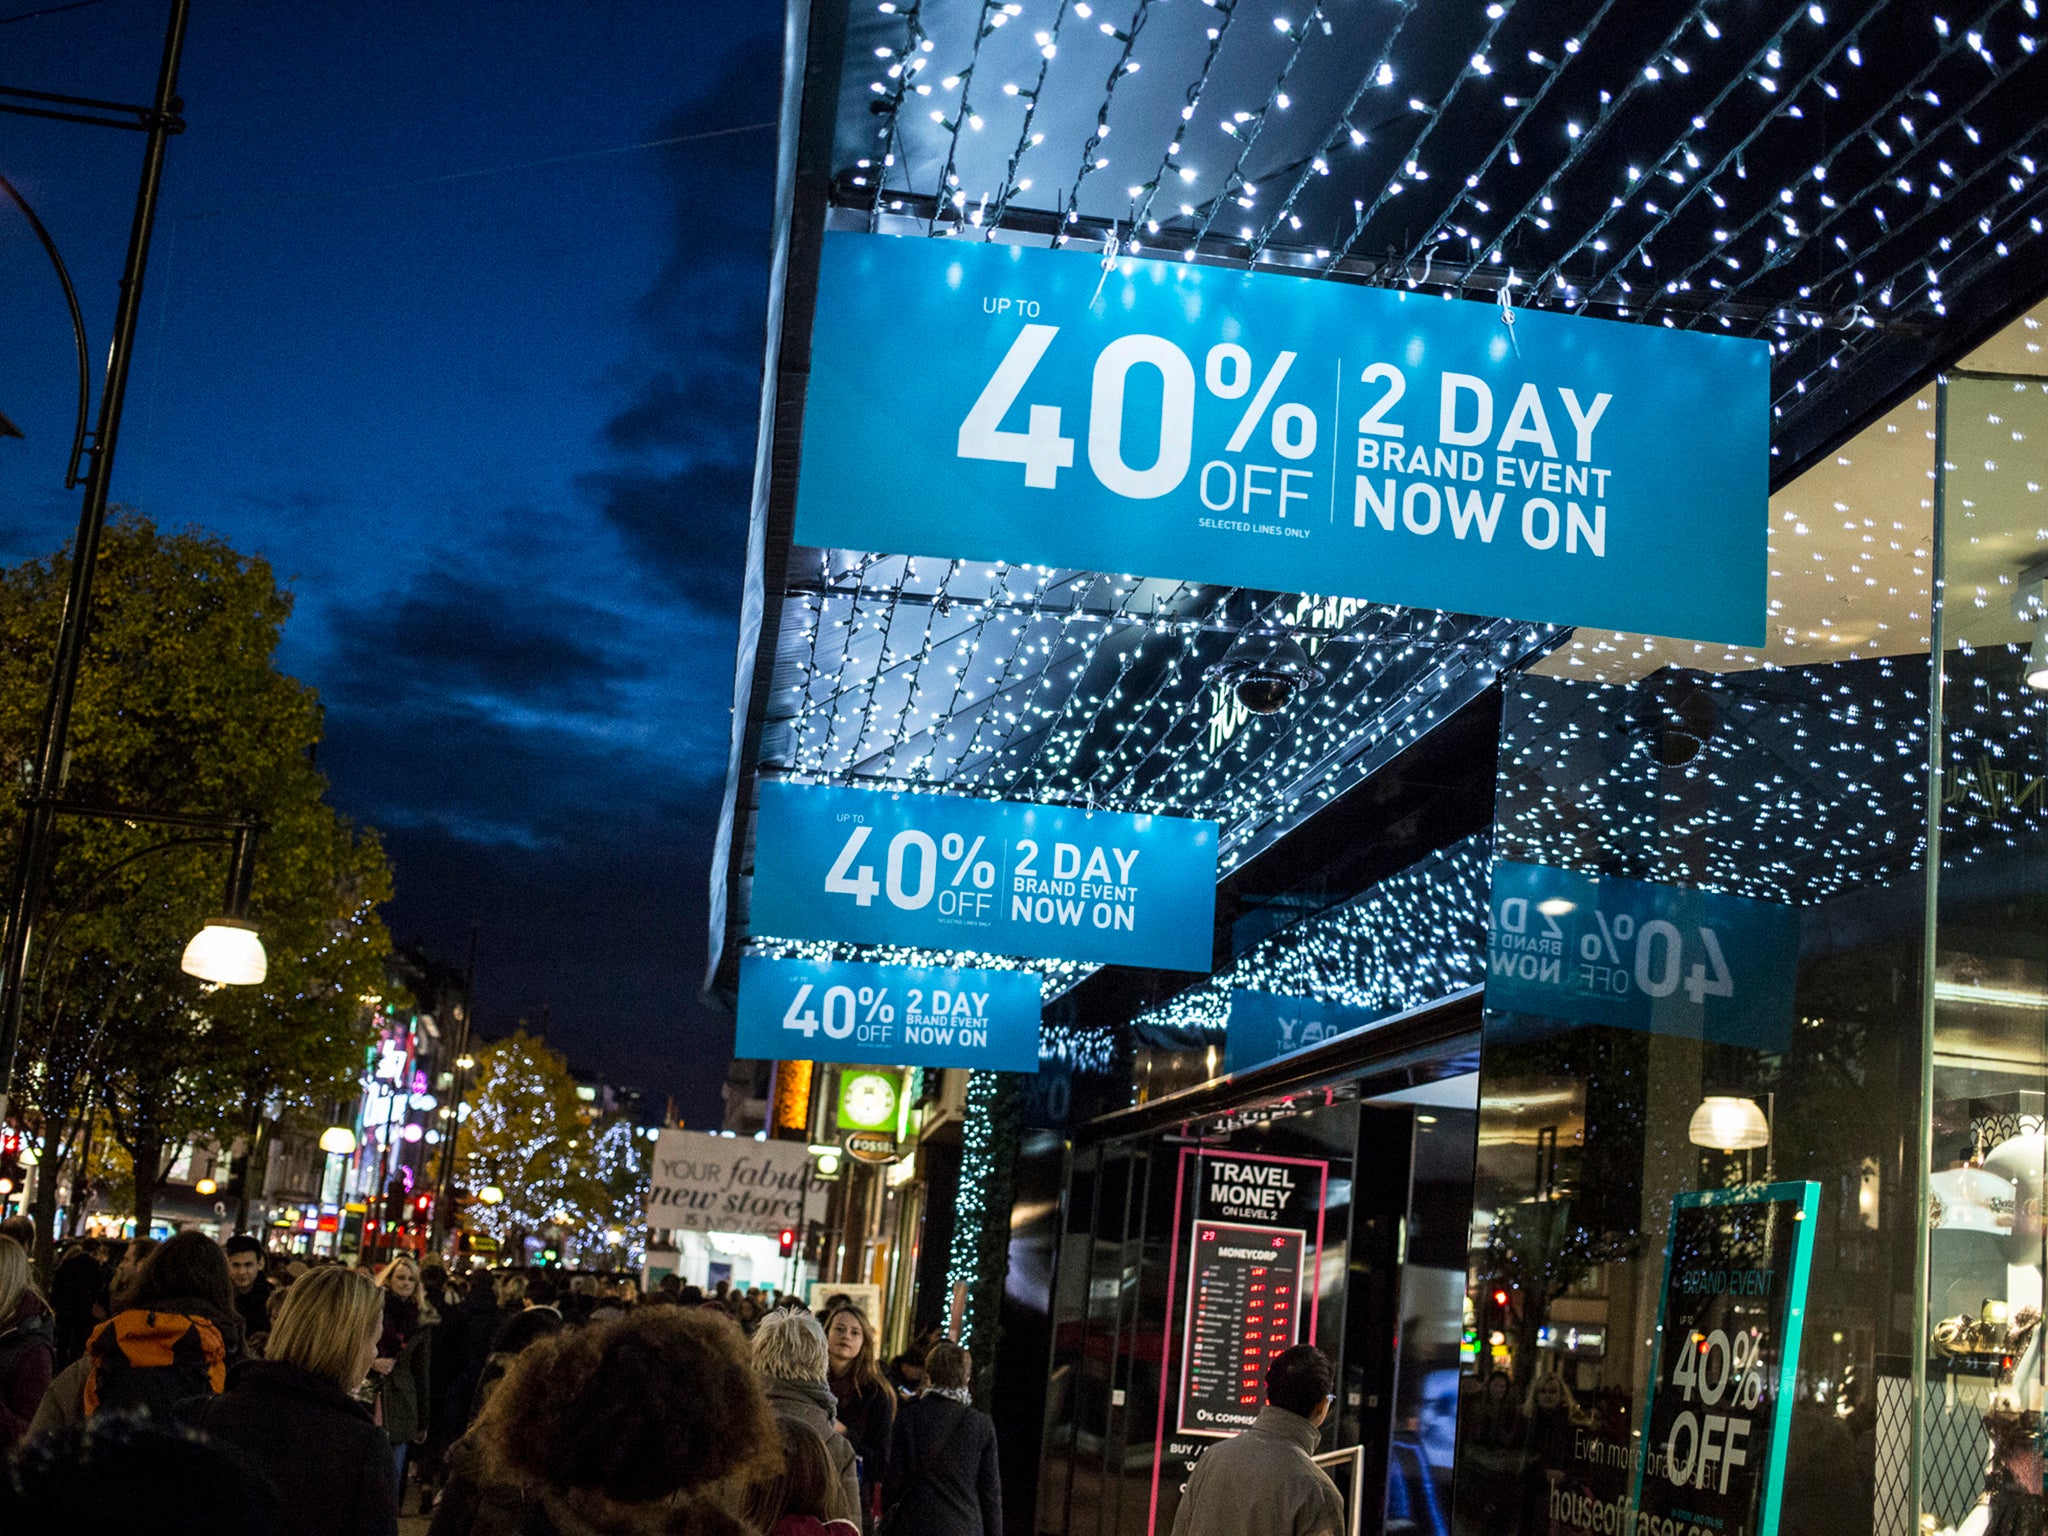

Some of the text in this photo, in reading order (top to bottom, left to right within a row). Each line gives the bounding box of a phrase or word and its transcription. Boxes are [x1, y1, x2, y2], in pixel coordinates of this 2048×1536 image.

[983, 297, 1041, 318] UP TO
[957, 322, 1318, 500] 40%
[1358, 362, 1614, 462] 2 DAY
[1357, 437, 1612, 499] BRAND EVENT
[1199, 460, 1314, 518] OFF
[1198, 517, 1311, 539] SELECTED LINES ONLY
[1354, 474, 1607, 558] NOW ON
[836, 813, 865, 825] UP TO
[824, 825, 996, 911] 40%
[1014, 838, 1140, 885] 2 DAY
[1013, 876, 1138, 903] BRAND EVENT
[938, 890, 993, 918] OFF
[1011, 895, 1135, 932] NOW ON
[782, 983, 895, 1040] 40%
[906, 988, 990, 1018] 2 DAY
[856, 1024, 893, 1042] OFF
[906, 1014, 989, 1029] BRAND EVENT
[904, 1026, 988, 1048] NOW ON
[661, 1158, 721, 1182] YOUR
[1209, 1161, 1296, 1189] TRAVEL
[651, 1186, 802, 1219] new store
[1209, 1183, 1292, 1210] MONEY
[1222, 1205, 1279, 1221] ON LEVEL 2
[1202, 1231, 1216, 1241] 29
[1217, 1246, 1279, 1261] MONEYCORP
[1729, 1270, 1776, 1297] EVENT
[1672, 1328, 1764, 1411] 40%
[1196, 1408, 1214, 1422] 0%
[1169, 1443, 1193, 1455] BUY
[1574, 1428, 1604, 1465] Even
[1667, 1410, 1752, 1496] OFF
